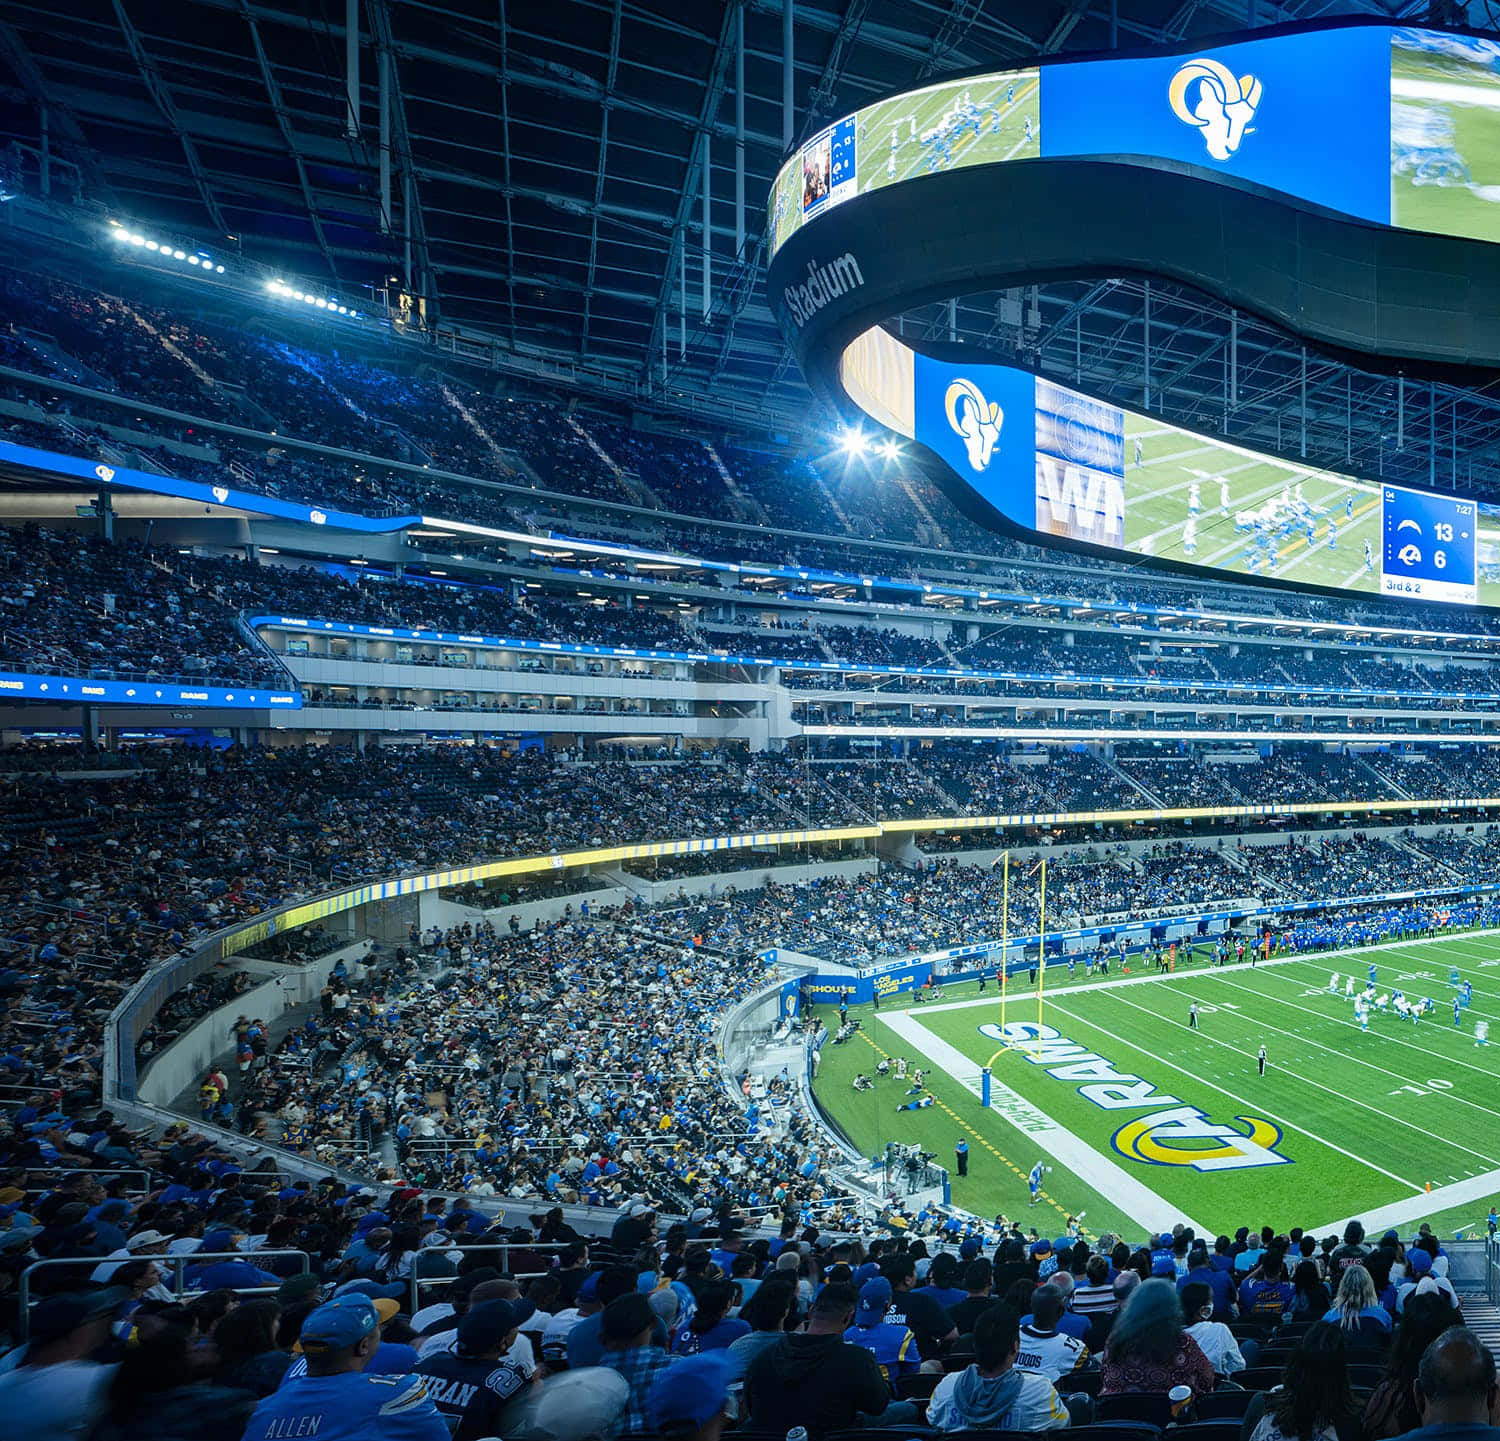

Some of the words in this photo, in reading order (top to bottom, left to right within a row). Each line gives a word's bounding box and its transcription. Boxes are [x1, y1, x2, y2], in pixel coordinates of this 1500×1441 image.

[785, 251, 865, 328] Stadium
[1456, 504, 1472, 515] 7:27
[1434, 522, 1453, 542] 13
[1434, 550, 1446, 569] 6
[1386, 580, 1403, 591] 3rd
[1414, 584, 1421, 593] 2
[874, 975, 891, 985] LOS
[978, 1021, 1186, 1111] RAMS
[1402, 1078, 1454, 1096] 10
[265, 1415, 322, 1440] ALLEN
